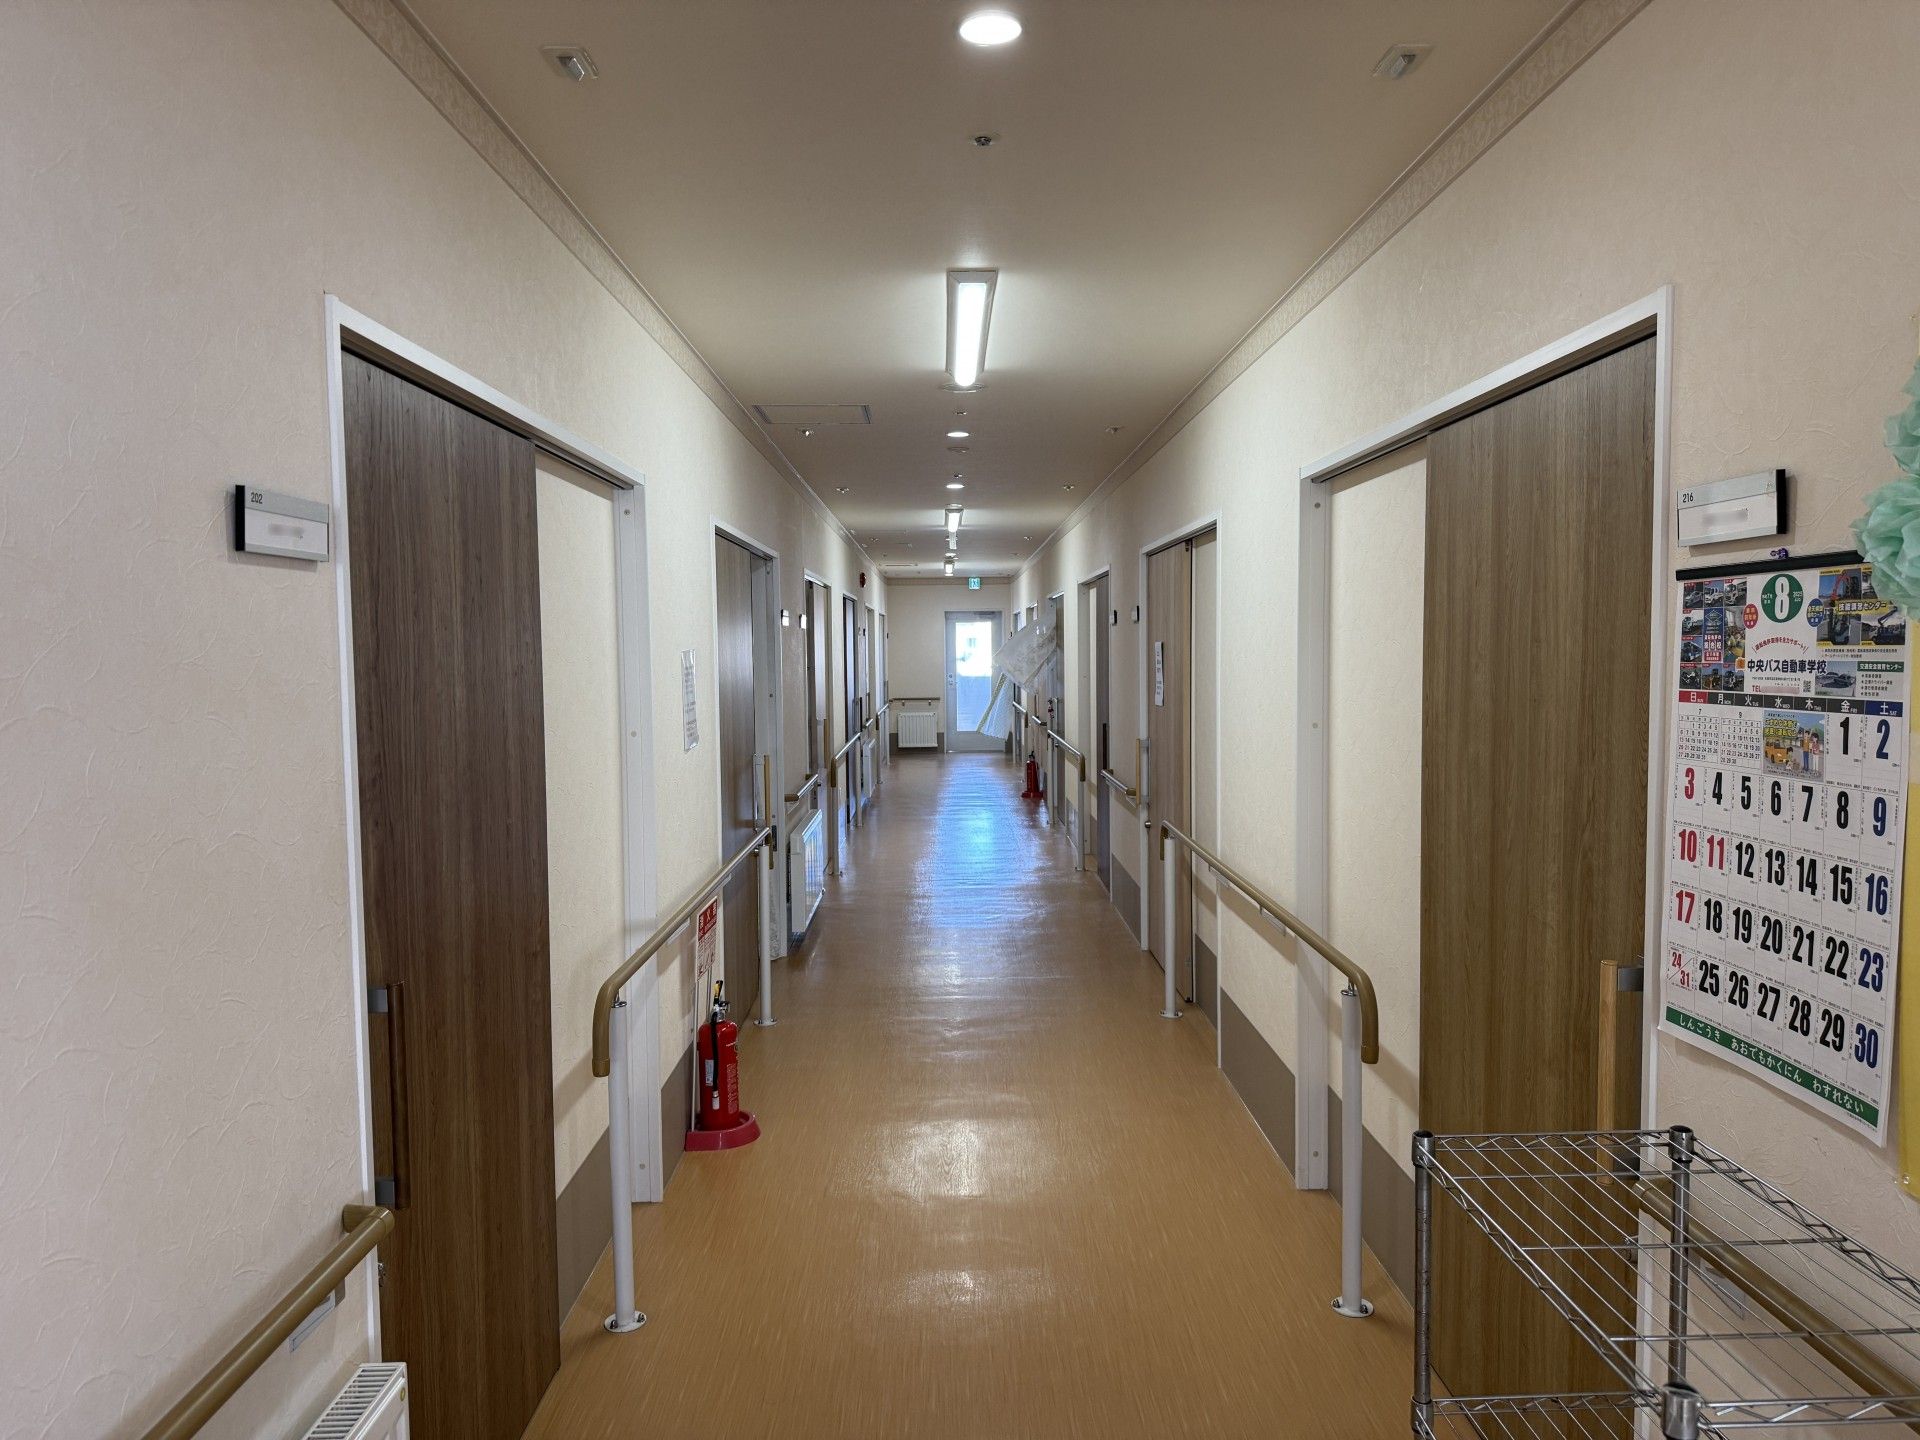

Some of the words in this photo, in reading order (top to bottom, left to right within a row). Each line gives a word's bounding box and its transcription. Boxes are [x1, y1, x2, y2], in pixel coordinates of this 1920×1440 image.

[251, 492, 263, 504] 202
[1682, 492, 1694, 503] 216
[1775, 577, 1789, 619] 8
[1747, 659, 1827, 674] 中央バス自動車学校
[1752, 685, 1761, 693] TEL
[1691, 692, 1696, 702] 日
[1718, 693, 1724, 704] 月
[1745, 695, 1752, 706] 火
[1774, 697, 1782, 708] 水
[1805, 698, 1814, 710] 木
[1841, 700, 1850, 713] 金
[1880, 702, 1889, 715] 土
[1839, 717, 1850, 756] 1
[1875, 719, 1891, 760] 2
[1684, 767, 1695, 800] 3
[1712, 771, 1723, 805] 4
[1740, 775, 1752, 810] 5
[1770, 780, 1782, 816] 6
[1801, 785, 1814, 822] 7
[1836, 790, 1849, 830] 8
[1873, 797, 1887, 837] 9
[1678, 828, 1698, 863] 10
[1706, 834, 1725, 871] 11
[1735, 841, 1755, 879] 12
[1764, 848, 1786, 886] 13
[1796, 855, 1818, 896] 14
[1829, 863, 1853, 905] 15
[1864, 873, 1889, 916] 16
[1675, 889, 1695, 924] 17
[1703, 897, 1723, 934] 18
[1732, 907, 1753, 944] 19
[1760, 915, 1783, 955] 20
[1791, 926, 1815, 967] 21
[1824, 936, 1850, 981] 22
[1858, 947, 1885, 993] 23
[1671, 951, 1682, 969] 24
[1679, 970, 1690, 987] 31
[1698, 960, 1720, 997] 25
[1728, 970, 1750, 1010] 26
[1757, 982, 1781, 1023] 27
[1788, 995, 1812, 1037] 28
[1819, 1008, 1846, 1053] 29
[1854, 1022, 1879, 1069] 30
[1679, 1014, 1721, 1042] しんごうき
[1731, 1038, 1802, 1083] あおでもかくにん
[1812, 1079, 1864, 1113] わすれない
